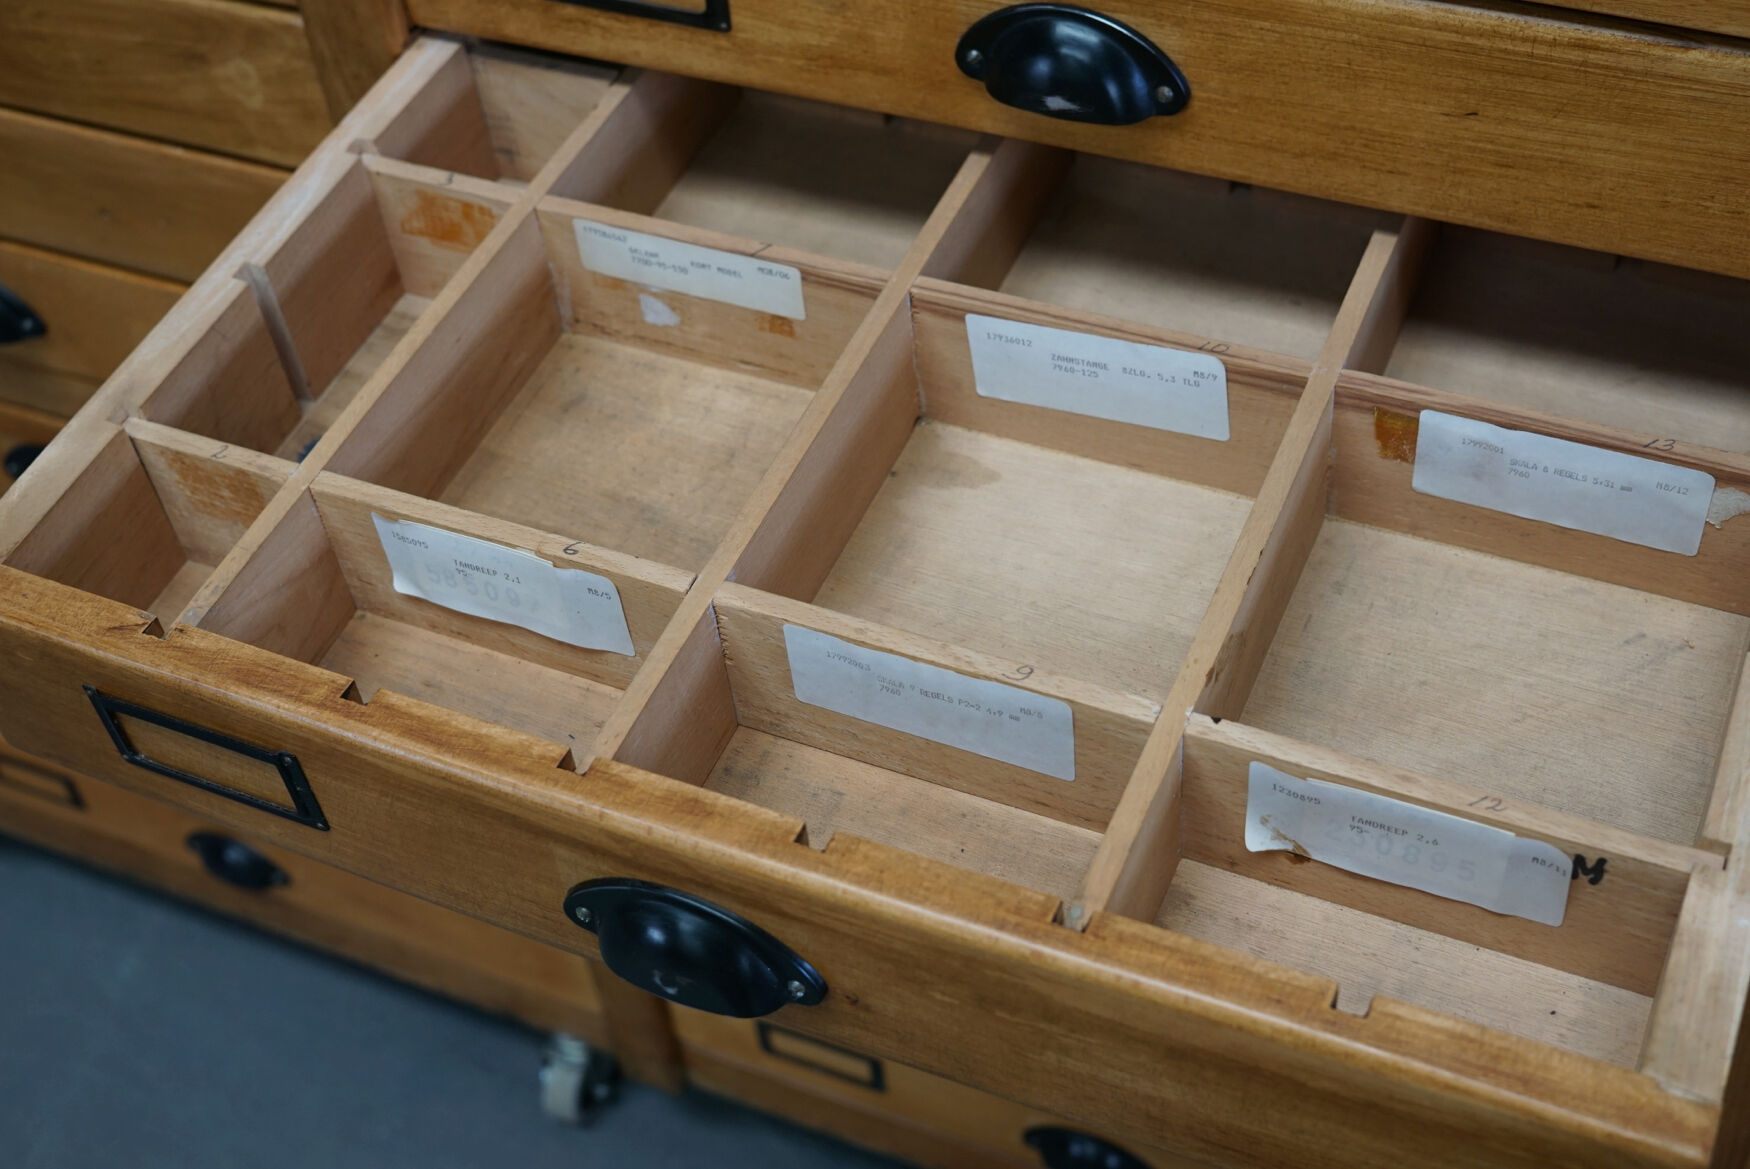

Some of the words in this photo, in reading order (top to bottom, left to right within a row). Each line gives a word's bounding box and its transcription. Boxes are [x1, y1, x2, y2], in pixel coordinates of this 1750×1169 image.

[1196, 341, 1232, 354] 10
[1051, 353, 1110, 372] ZAHNSTANGE
[1051, 364, 1100, 379] 7960-125
[1642, 438, 1676, 452] 13
[1507, 467, 1531, 480] 7960
[562, 541, 586, 556] 6
[1001, 664, 1035, 682] 9
[878, 684, 902, 698] 7960
[919, 687, 954, 705] REGELS
[1467, 795, 1507, 812] 12
[1351, 815, 1409, 837] TANDREEP
[1571, 853, 1608, 886] M
